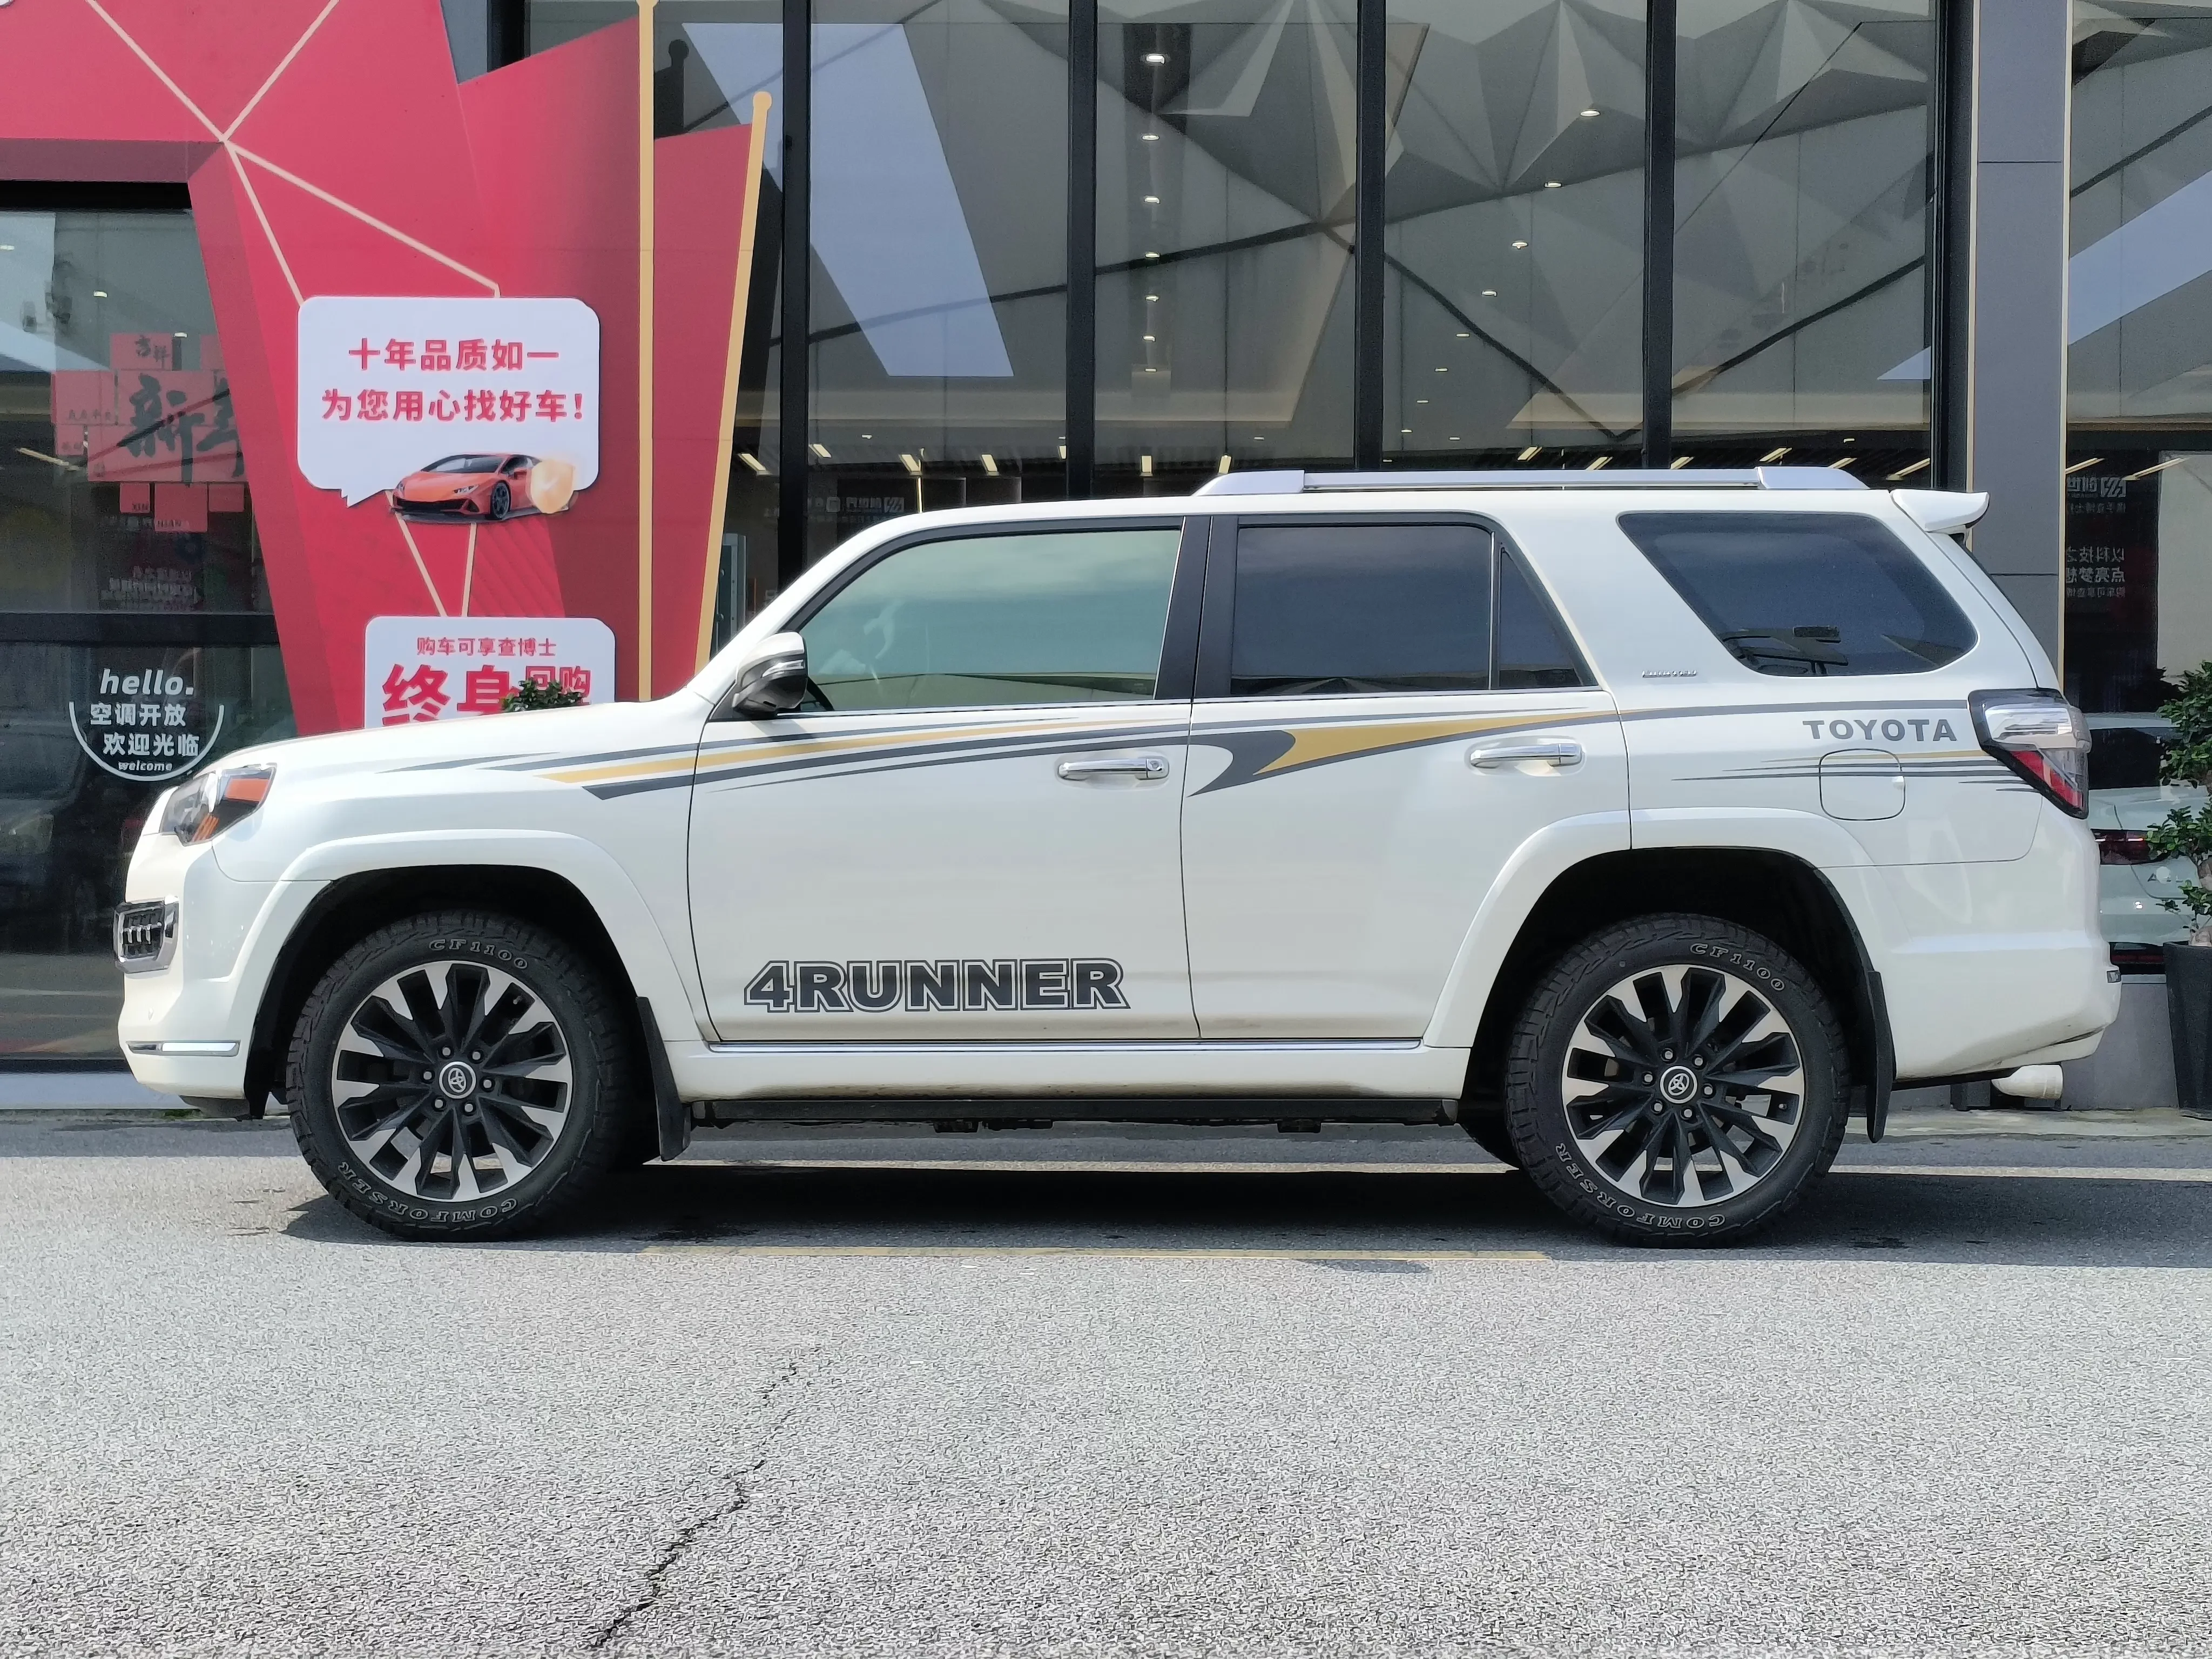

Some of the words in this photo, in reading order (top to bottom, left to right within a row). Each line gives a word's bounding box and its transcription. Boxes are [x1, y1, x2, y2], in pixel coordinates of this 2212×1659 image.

[348, 338, 558, 371] 十年品质如一
[322, 389, 583, 422] 为您用心找好车!
[417, 637, 557, 656] 购车可享查博士
[90, 703, 186, 727] 空调开放
[1802, 719, 1958, 742] TOYOTA
[103, 733, 200, 757] 欢迎光临
[118, 760, 173, 772] welcome
[429, 939, 528, 969] CF1100
[1690, 943, 1785, 991] CF1100
[744, 958, 1131, 1013] 4RUNNER
[338, 1162, 516, 1222] COMFORSER
[1555, 1143, 1725, 1229] COMFORSER
